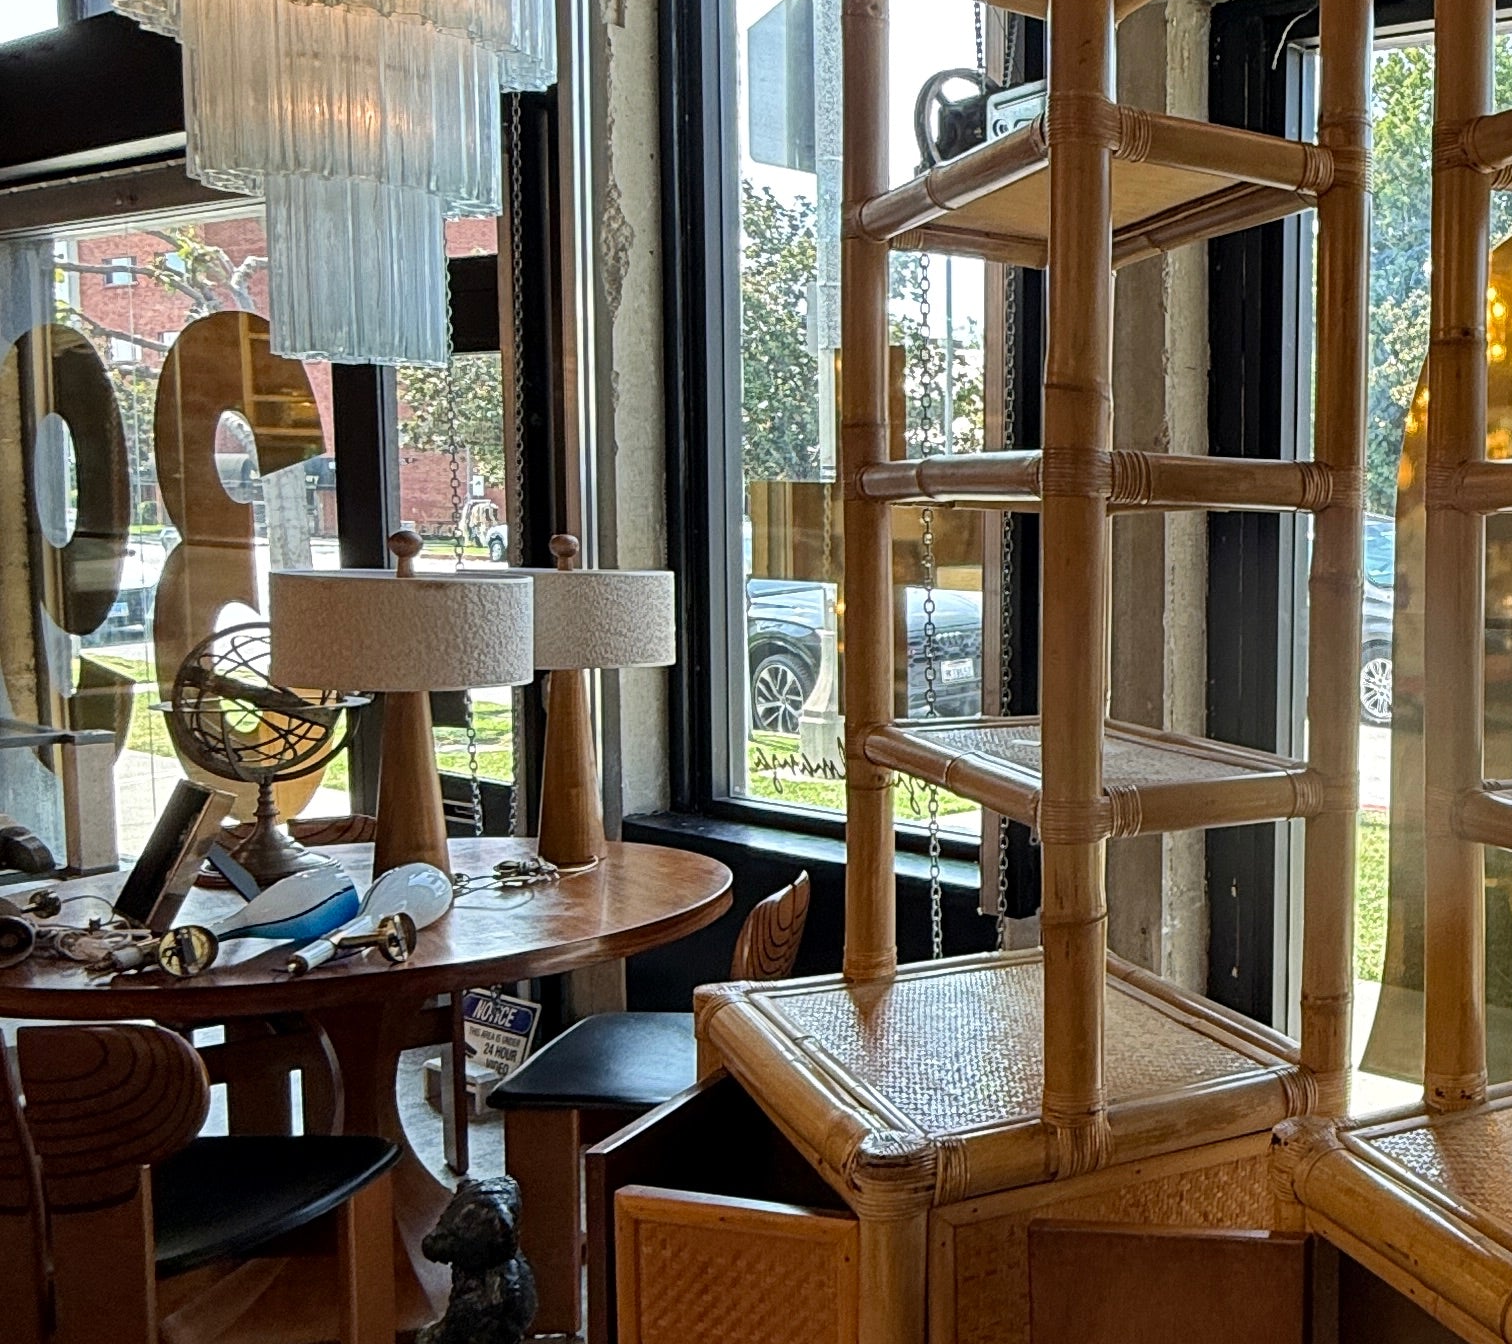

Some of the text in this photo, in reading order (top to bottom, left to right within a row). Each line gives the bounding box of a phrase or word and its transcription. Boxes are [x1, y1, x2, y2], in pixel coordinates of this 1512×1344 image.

[481, 1029, 495, 1041] AREA
[483, 1042, 518, 1063] 24 HOUR
[485, 1057, 510, 1077] VIDEO
